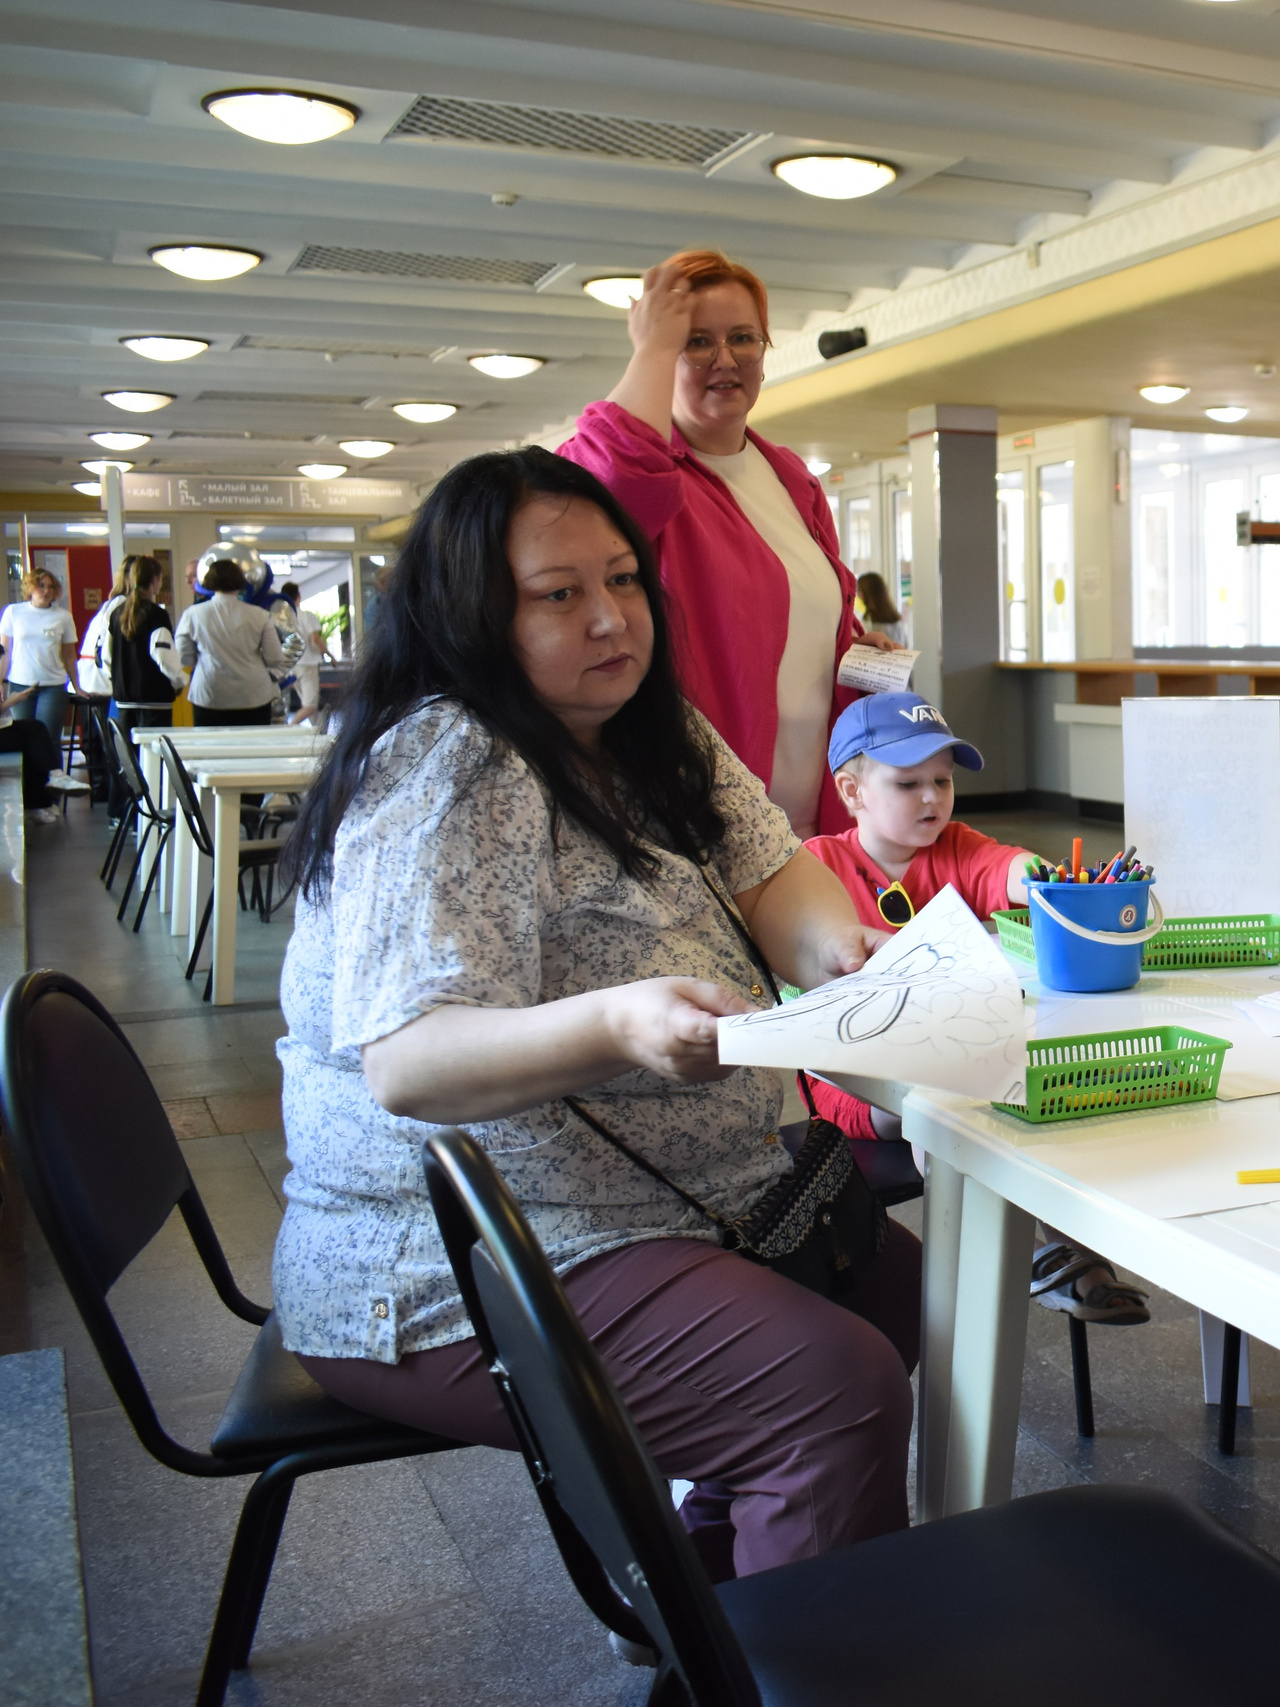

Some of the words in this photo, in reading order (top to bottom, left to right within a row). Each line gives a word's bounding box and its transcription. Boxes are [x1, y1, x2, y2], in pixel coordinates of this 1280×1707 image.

[208, 482, 247, 492] МАЛЫЙ
[250, 484, 269, 492] ЗАЛ
[328, 486, 402, 497] ТАНЦЕВАЛЬНЫЙ
[132, 489, 160, 498] КАФЕ
[208, 494, 261, 504] БАЛЕТНЫЙ
[264, 496, 283, 505] ЗАЛ
[327, 497, 347, 505] ЗАЛ
[899, 705, 948, 727] VAN
